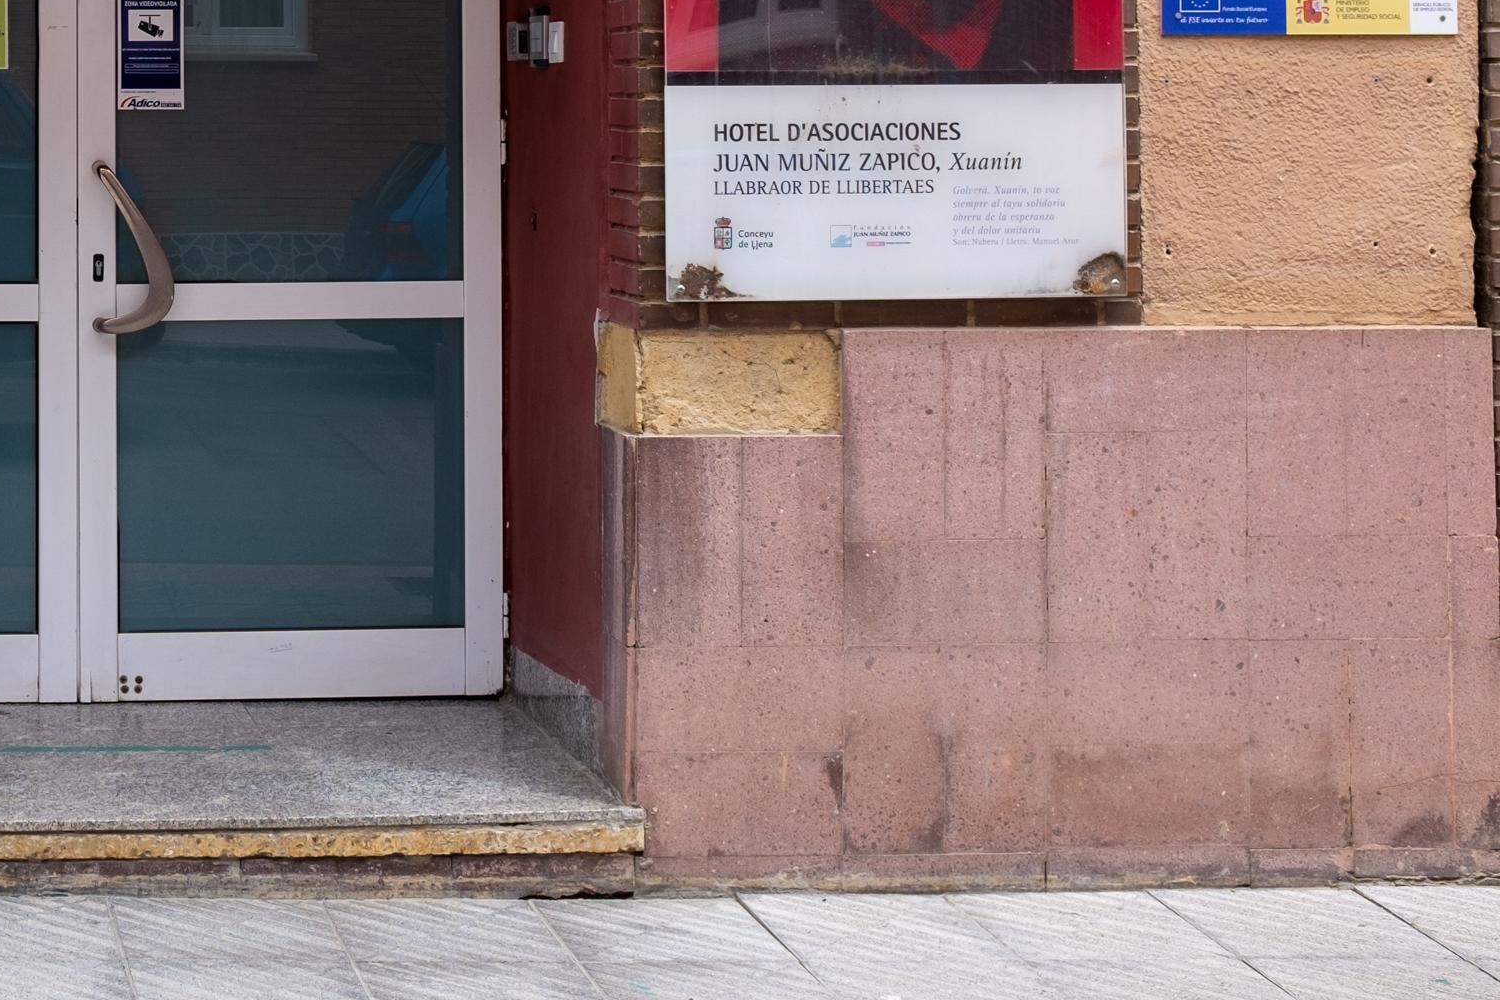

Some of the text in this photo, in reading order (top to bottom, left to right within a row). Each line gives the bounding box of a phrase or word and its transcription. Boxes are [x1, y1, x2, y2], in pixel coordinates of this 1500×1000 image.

[128, 97, 161, 108] Adico
[714, 122, 962, 142] HOTEL D'ASOCIACIONES
[712, 148, 1022, 174] JUAN MUÑIZ ZAPICO, Xuanín
[714, 178, 934, 196] LLABRAOR DE LLIBERTAES
[738, 230, 774, 240] Conceyu
